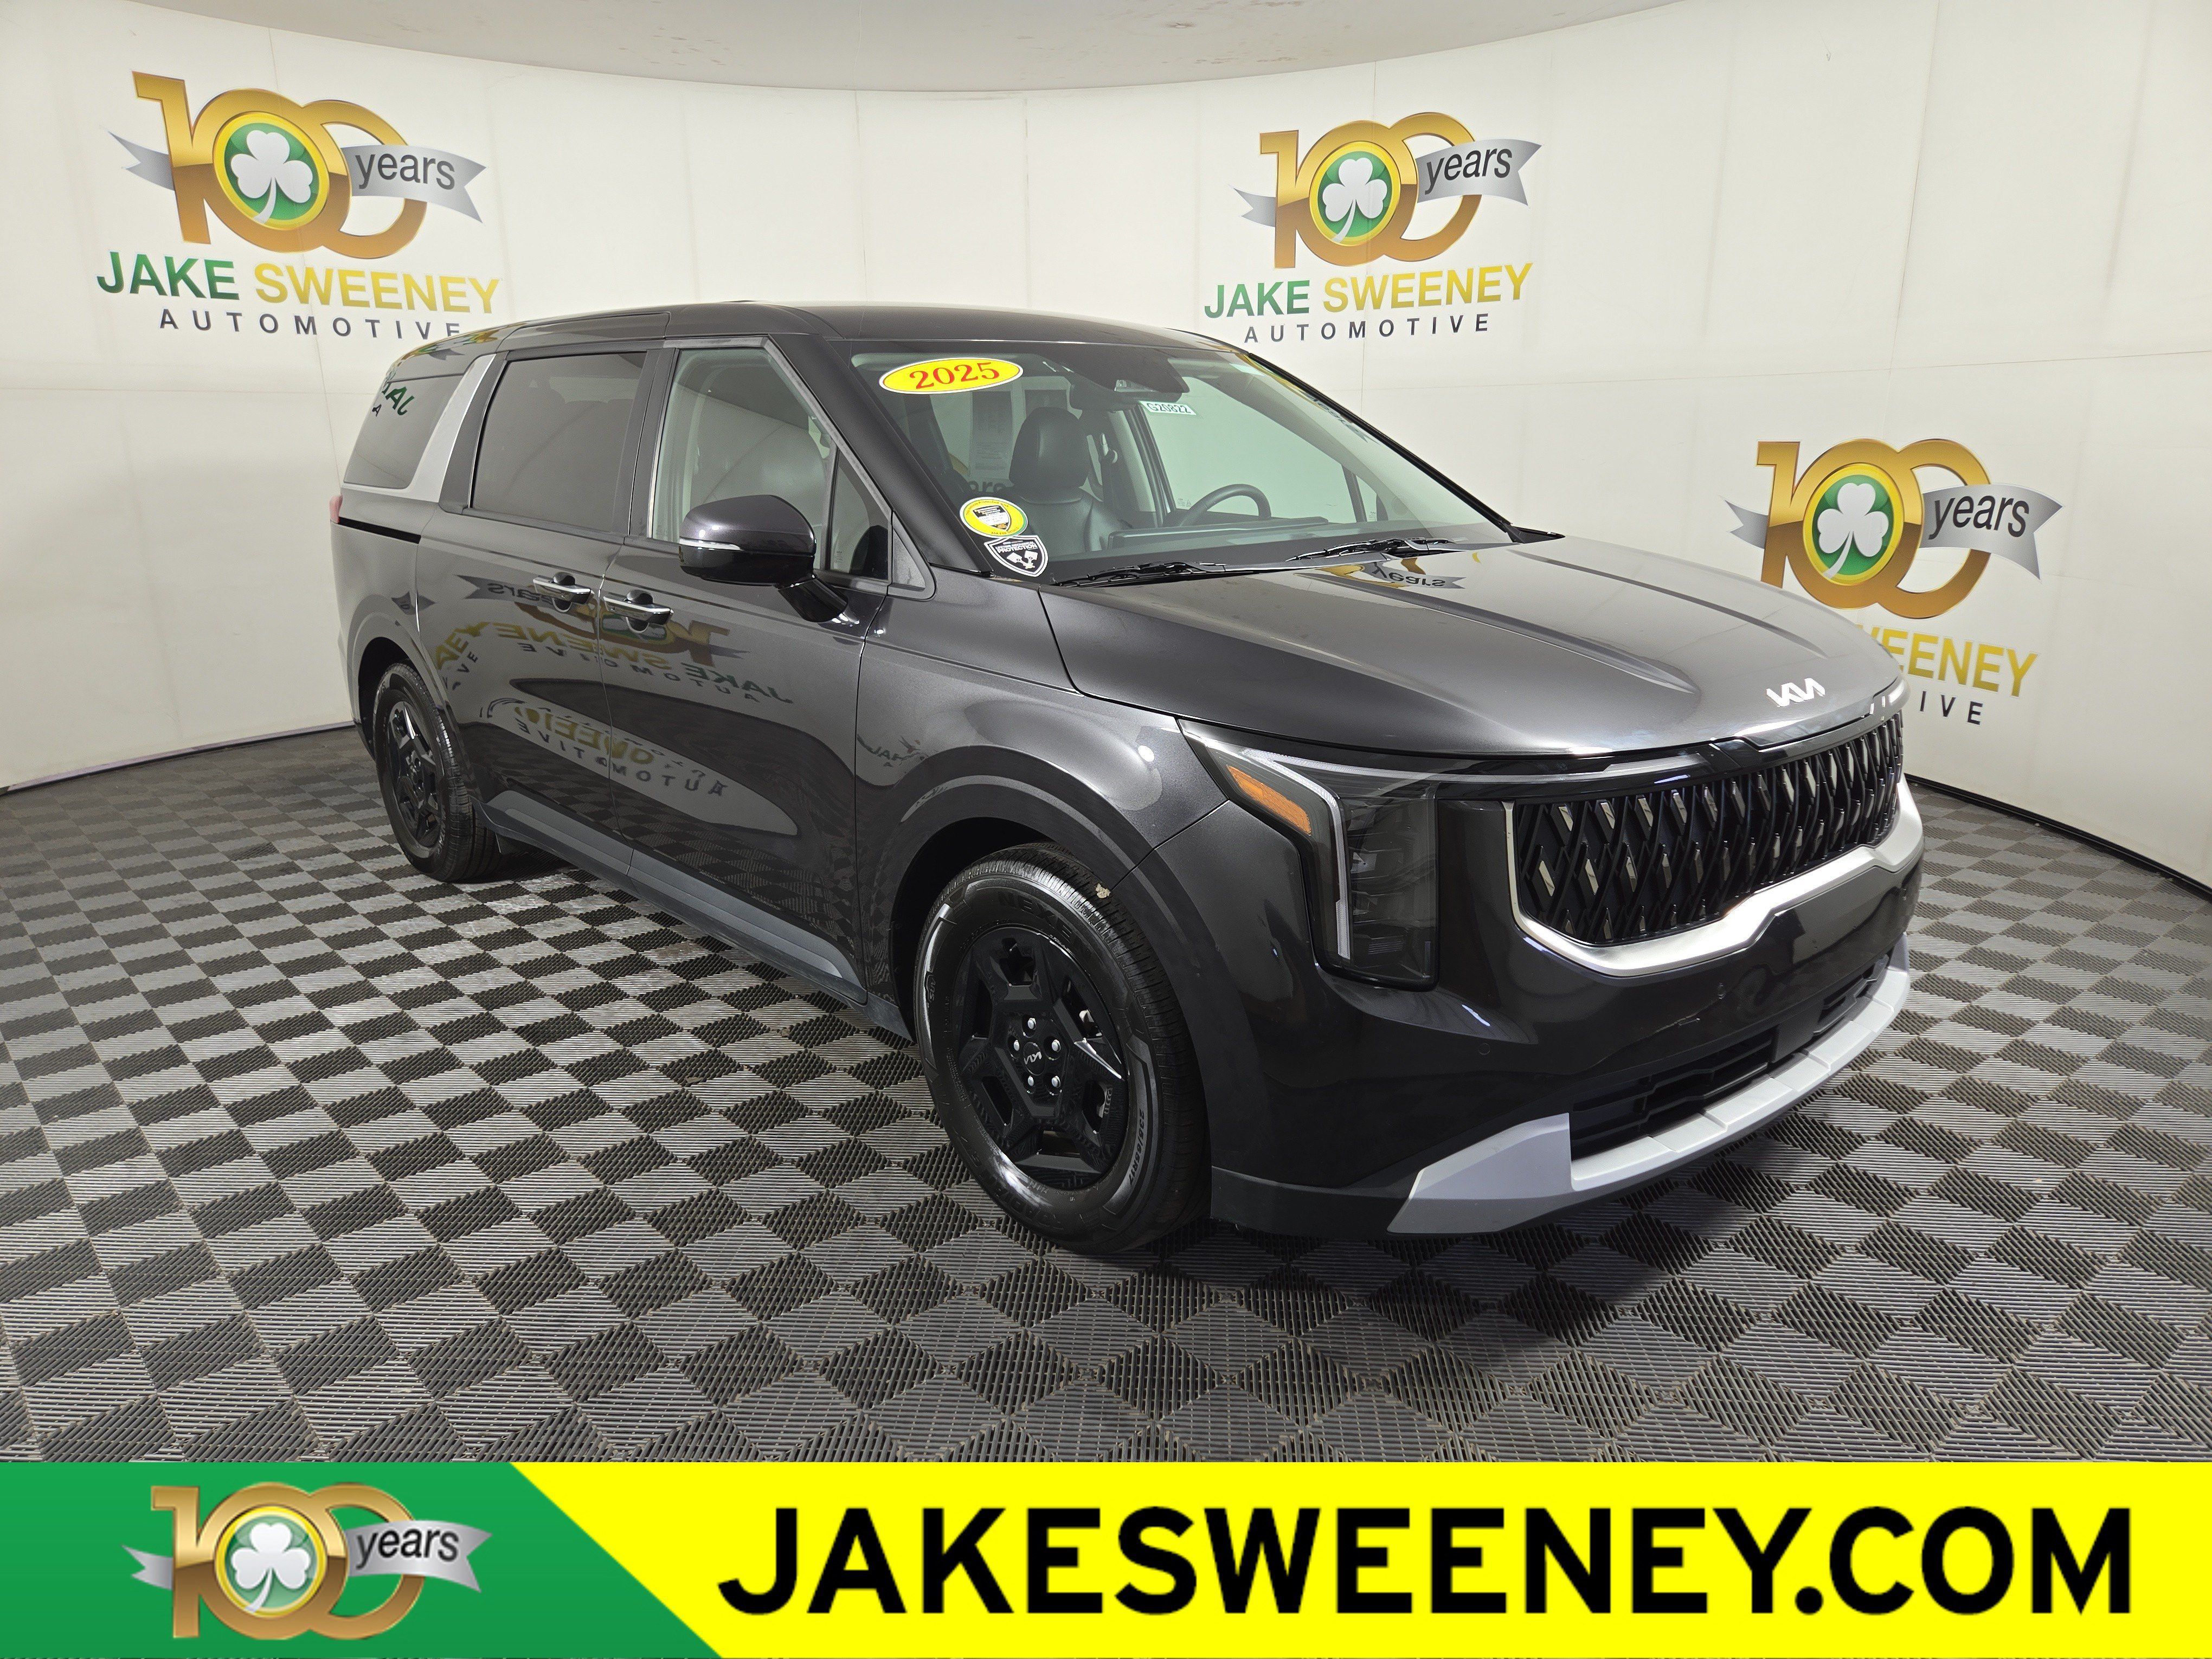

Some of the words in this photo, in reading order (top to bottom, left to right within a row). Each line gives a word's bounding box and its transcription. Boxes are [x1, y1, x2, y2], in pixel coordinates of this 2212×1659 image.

[131, 70, 427, 259] 100
[355, 152, 455, 190] years
[1259, 112, 1482, 269] 100
[1424, 147, 1513, 196] years
[97, 251, 240, 300] JAKE
[254, 262, 500, 314] SWEENEY
[1204, 279, 1310, 319] JAKE
[1322, 262, 1534, 313] SWEENEY
[159, 308, 460, 340] AUTOMOTIVE
[1244, 313, 1489, 343] AUTOMOTIVE
[909, 362, 1000, 389] 2025
[1147, 403, 1192, 413] G20822
[1756, 438, 1991, 619] 100
[1928, 494, 2030, 538] years
